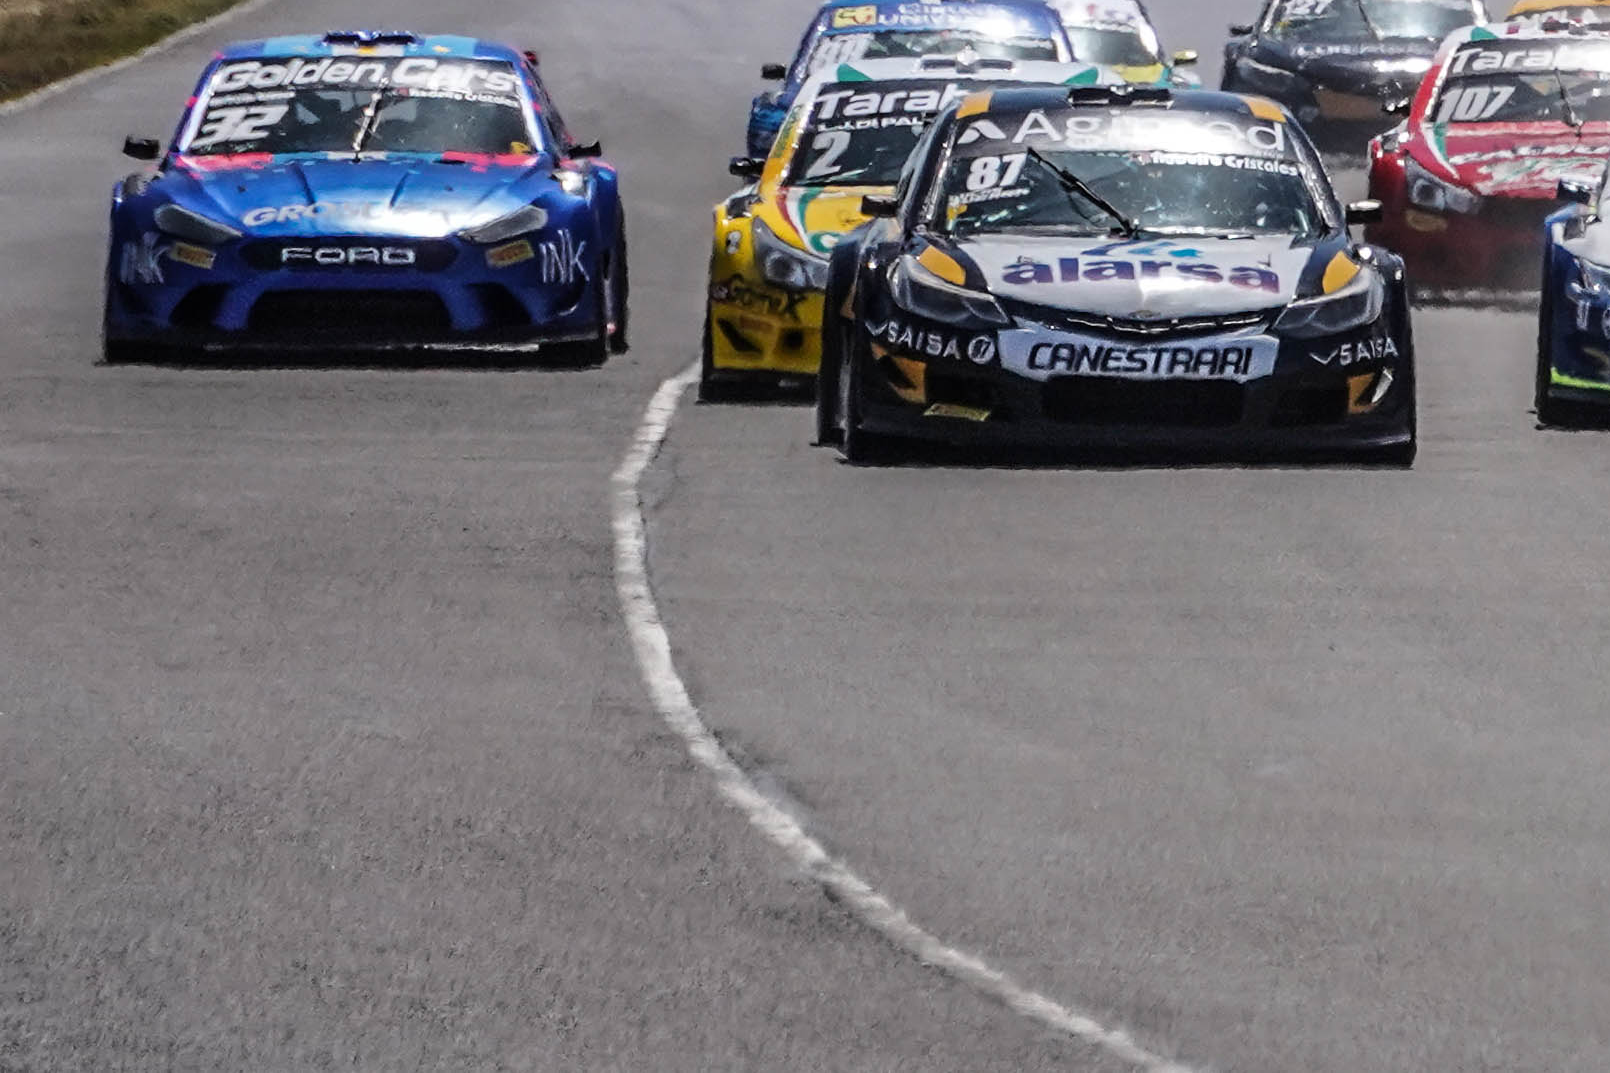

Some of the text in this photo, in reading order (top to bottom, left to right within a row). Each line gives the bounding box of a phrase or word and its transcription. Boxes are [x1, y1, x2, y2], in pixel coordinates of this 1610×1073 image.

[214, 57, 521, 94] Golden Cars
[1437, 86, 1516, 123] 107
[191, 104, 290, 151] 32
[806, 130, 851, 178] 2
[966, 152, 1028, 192] 87
[1225, 154, 1300, 178] Cristales
[281, 246, 416, 265] FORD
[1001, 257, 1280, 294] alarsa
[886, 320, 961, 360] SAISA
[1026, 342, 1255, 376] CANESTRARI
